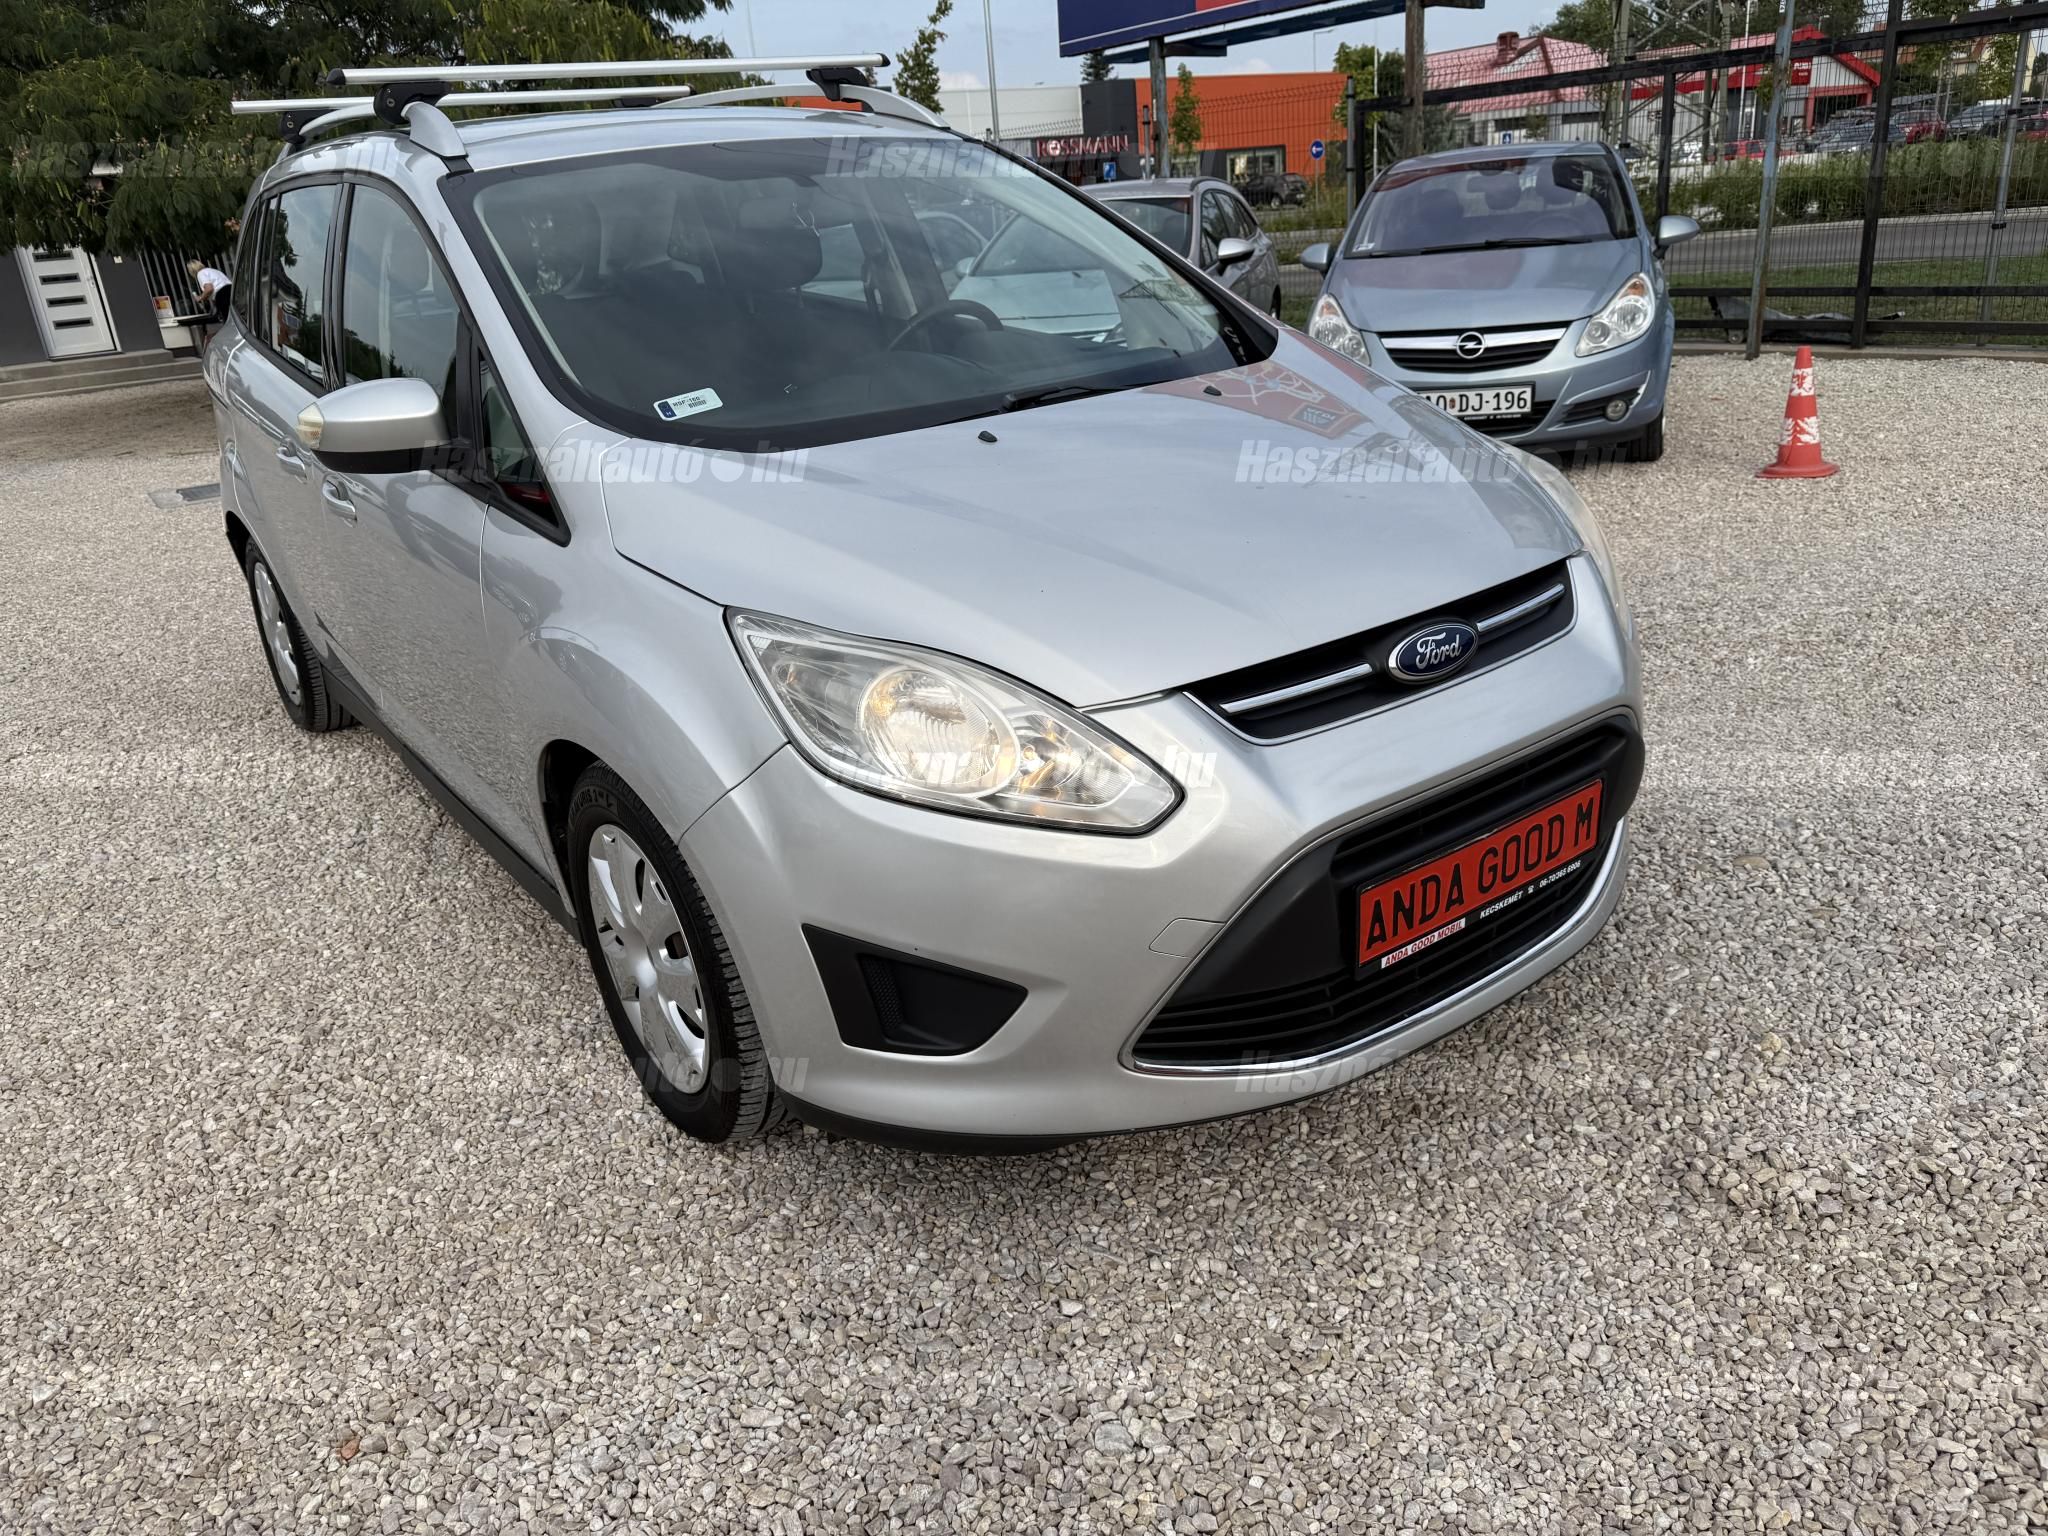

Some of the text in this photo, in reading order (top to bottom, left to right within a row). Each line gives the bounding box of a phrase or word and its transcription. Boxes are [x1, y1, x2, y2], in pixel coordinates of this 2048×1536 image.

[1036, 135, 1128, 157] ROSSMANN
[1458, 390, 1528, 413] DJ-196
[1415, 631, 1461, 670] Ford
[1366, 796, 1595, 951] ANDA GOOD M
[1480, 889, 1524, 919] KECSKEMÉT
[1385, 920, 1463, 967] ANDA GOOD MOBIL
